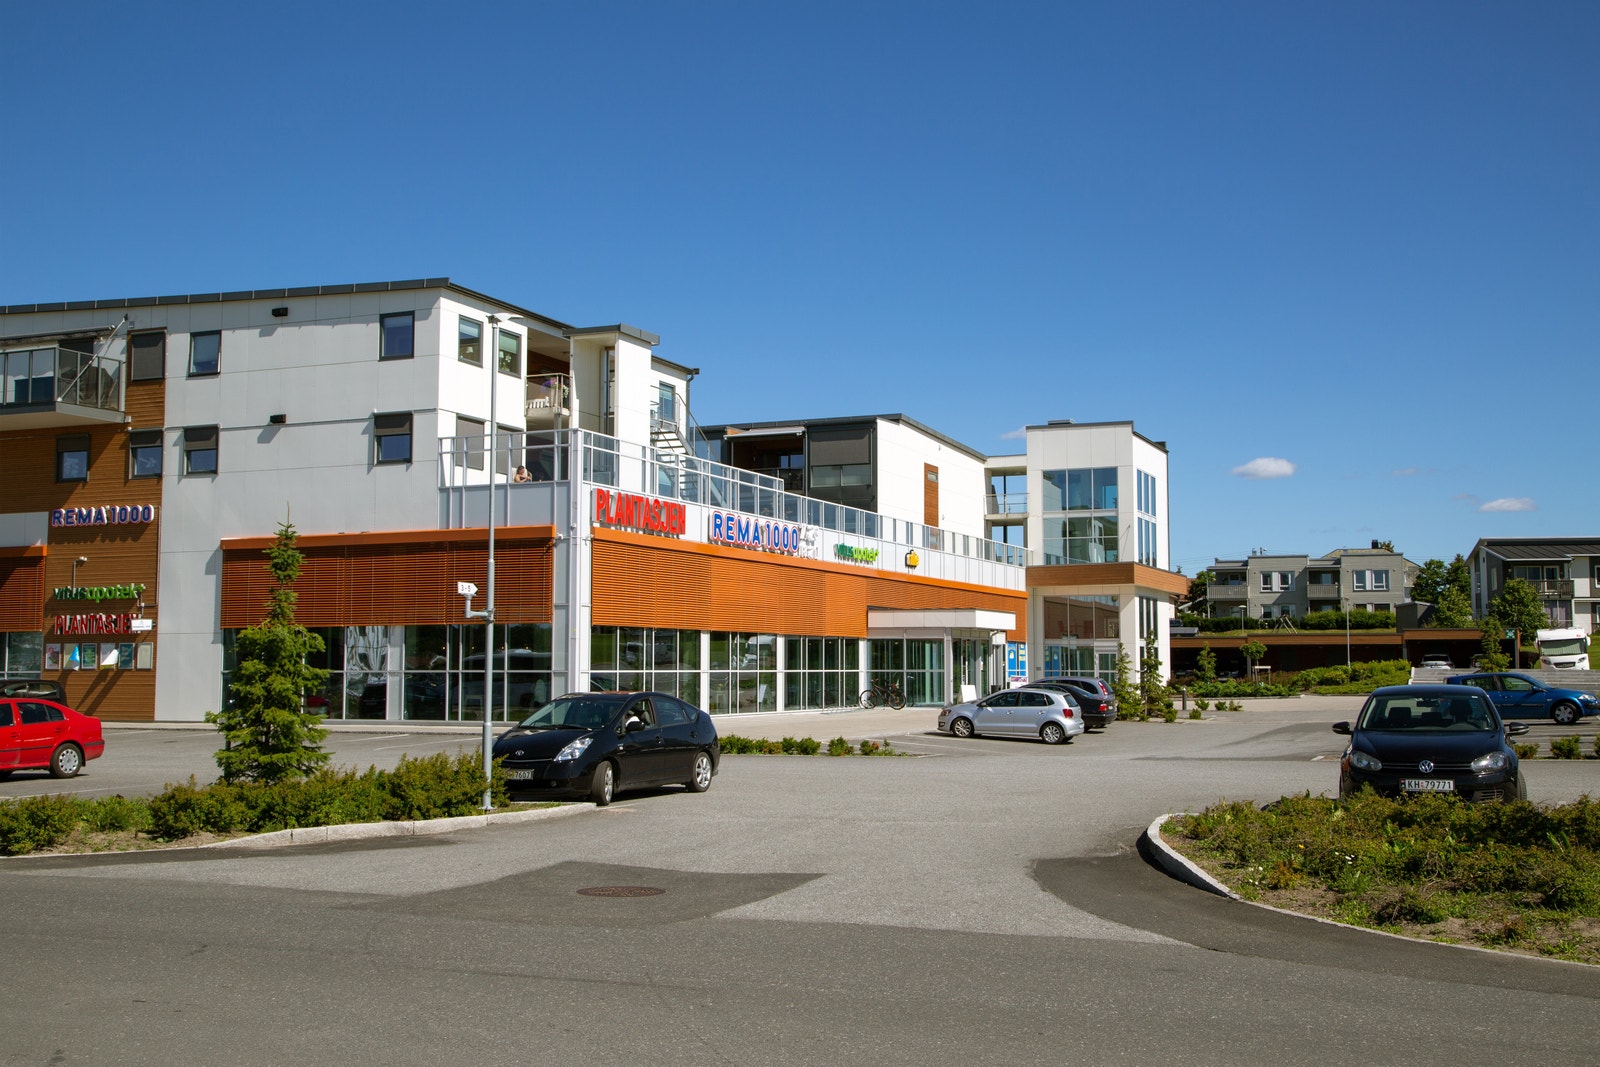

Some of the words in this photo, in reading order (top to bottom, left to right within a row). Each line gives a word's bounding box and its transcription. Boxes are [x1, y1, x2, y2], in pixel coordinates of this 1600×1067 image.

[51, 507, 107, 527] REMA
[110, 504, 154, 525] 1000
[593, 488, 686, 535] PLANTASJEN
[712, 510, 762, 548] REMA
[765, 521, 799, 553] 1000
[53, 583, 139, 603] vitusapotek
[1407, 781, 1420, 789] KH
[1425, 781, 1452, 789] 79771
